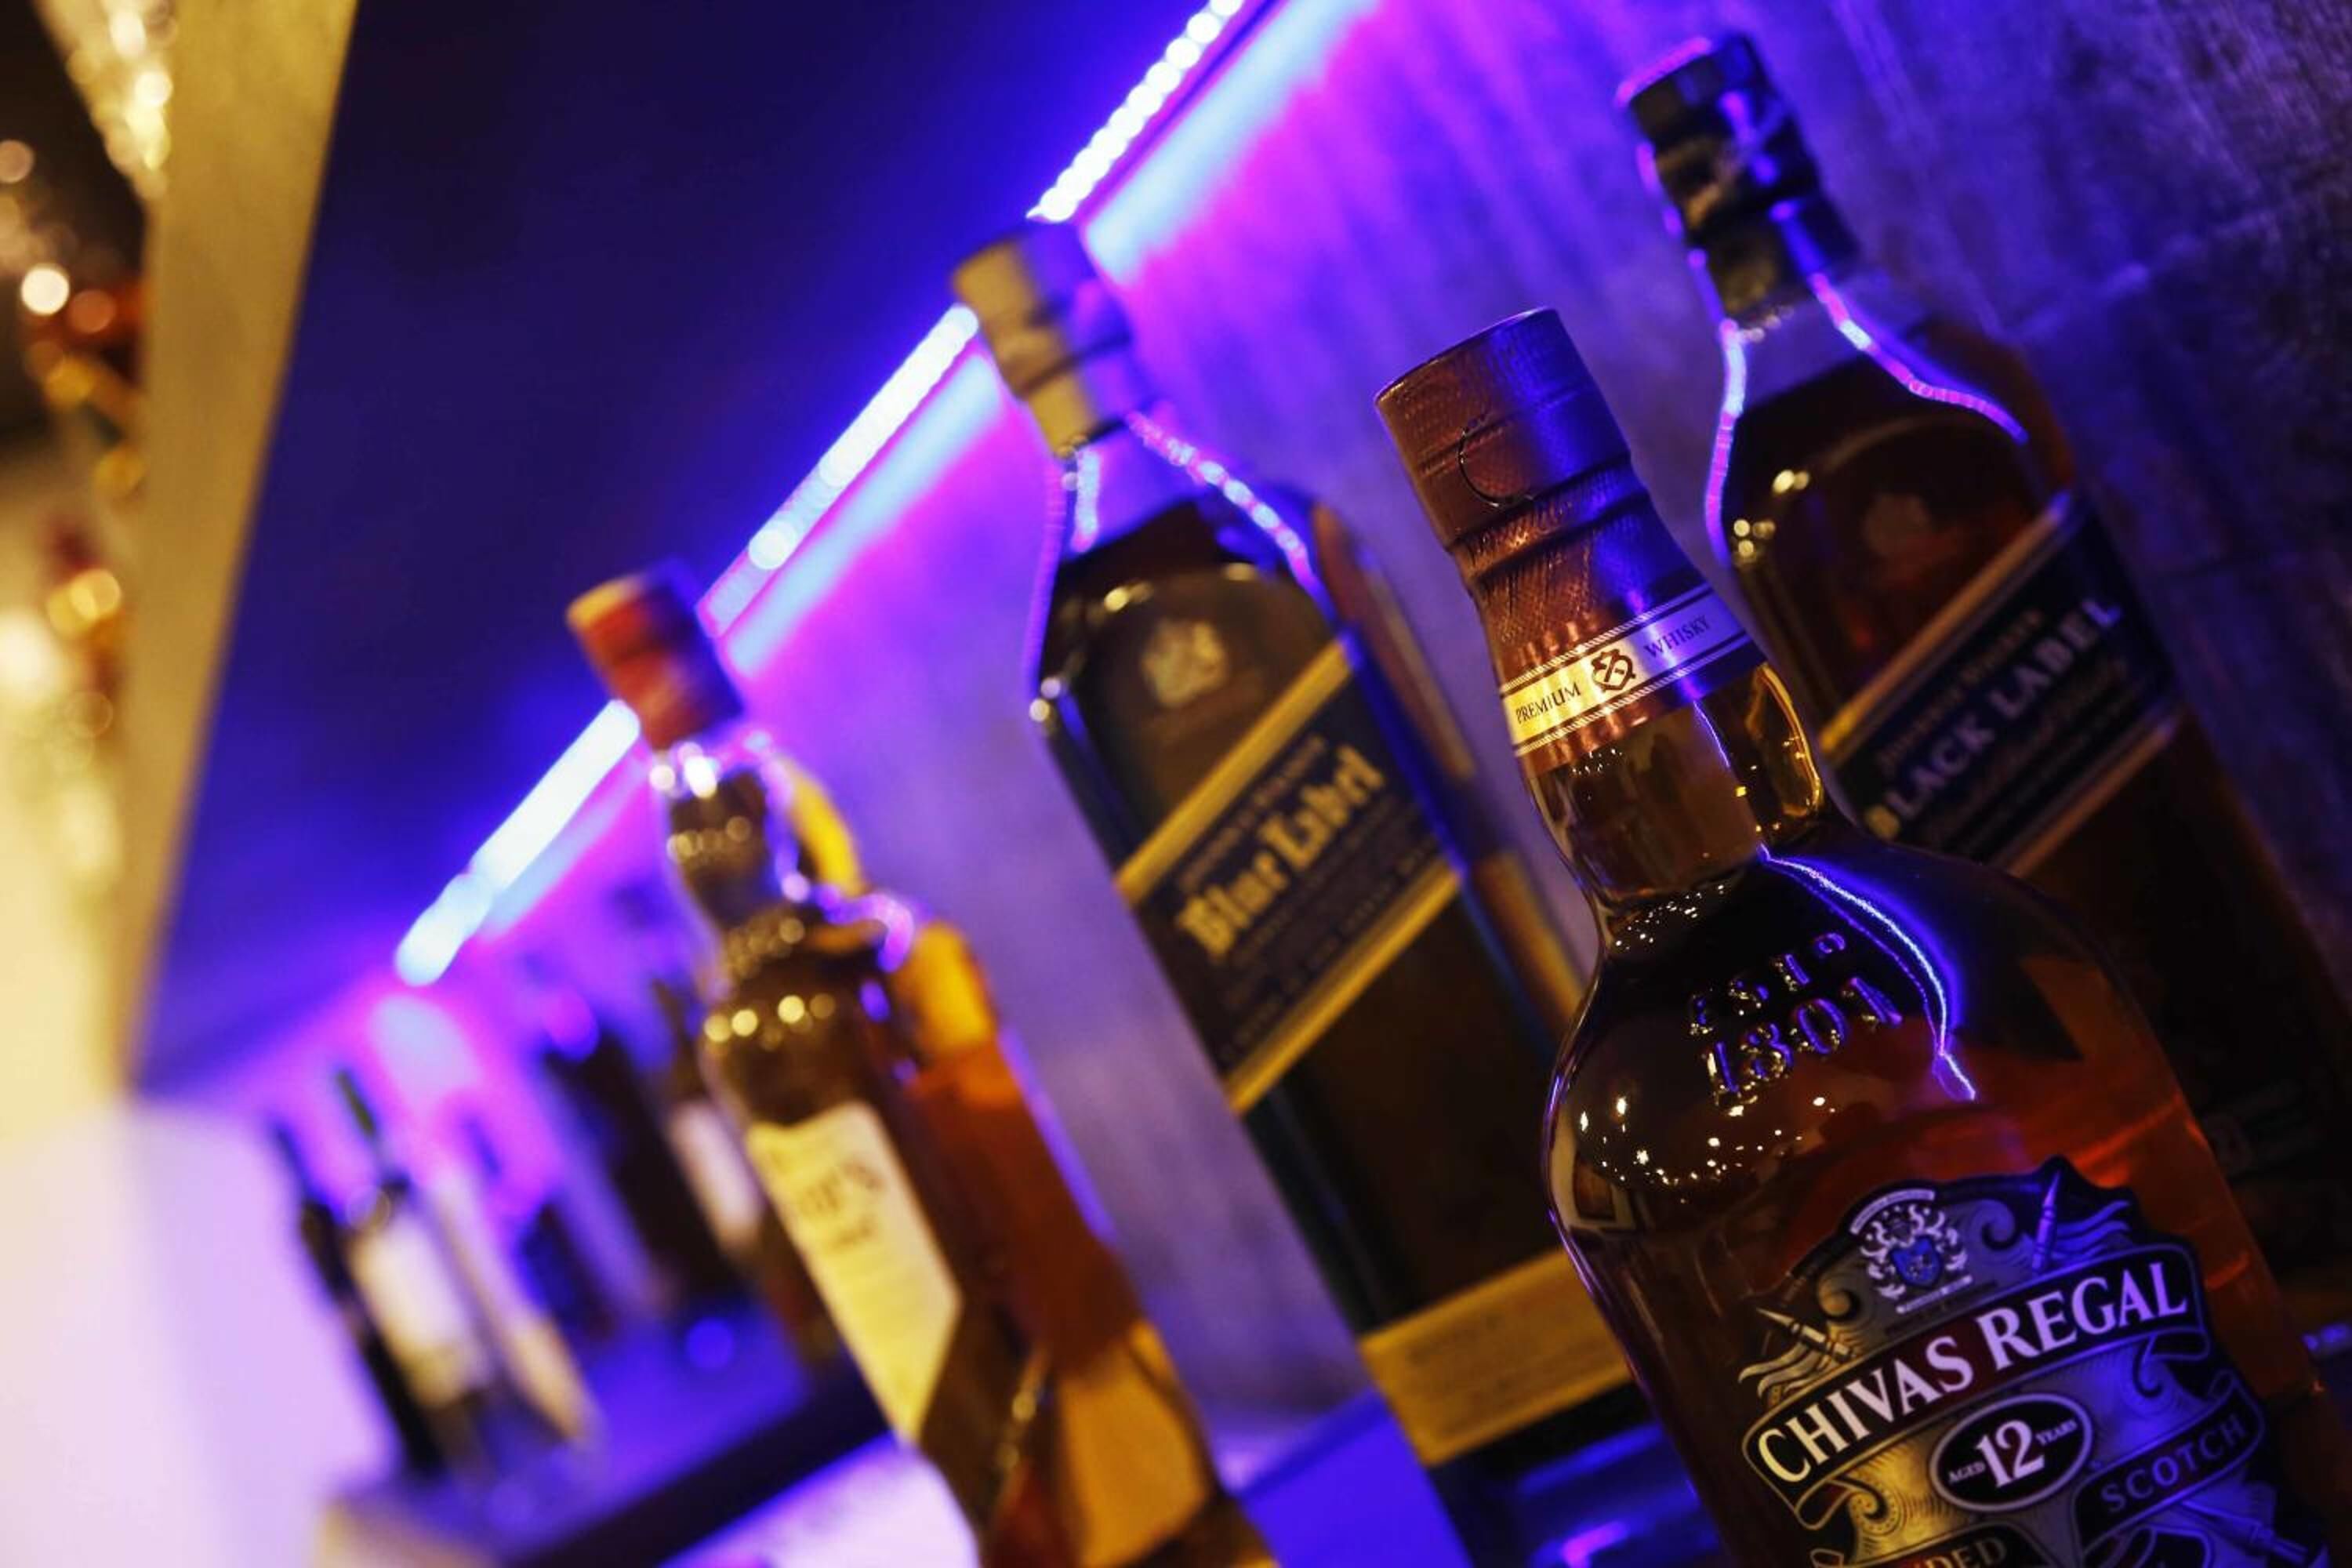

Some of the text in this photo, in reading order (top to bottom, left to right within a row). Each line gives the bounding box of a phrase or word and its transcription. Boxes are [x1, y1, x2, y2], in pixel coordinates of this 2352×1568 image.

[1515, 615, 1711, 725] PREMIUM WHISKY
[1756, 1336, 1975, 1484] CHIVAS
[1974, 1261, 2190, 1370] REGAL
[1947, 1418, 2078, 1488] AGED 12 YEARS
[2100, 1414, 2248, 1513] SCOTCH
